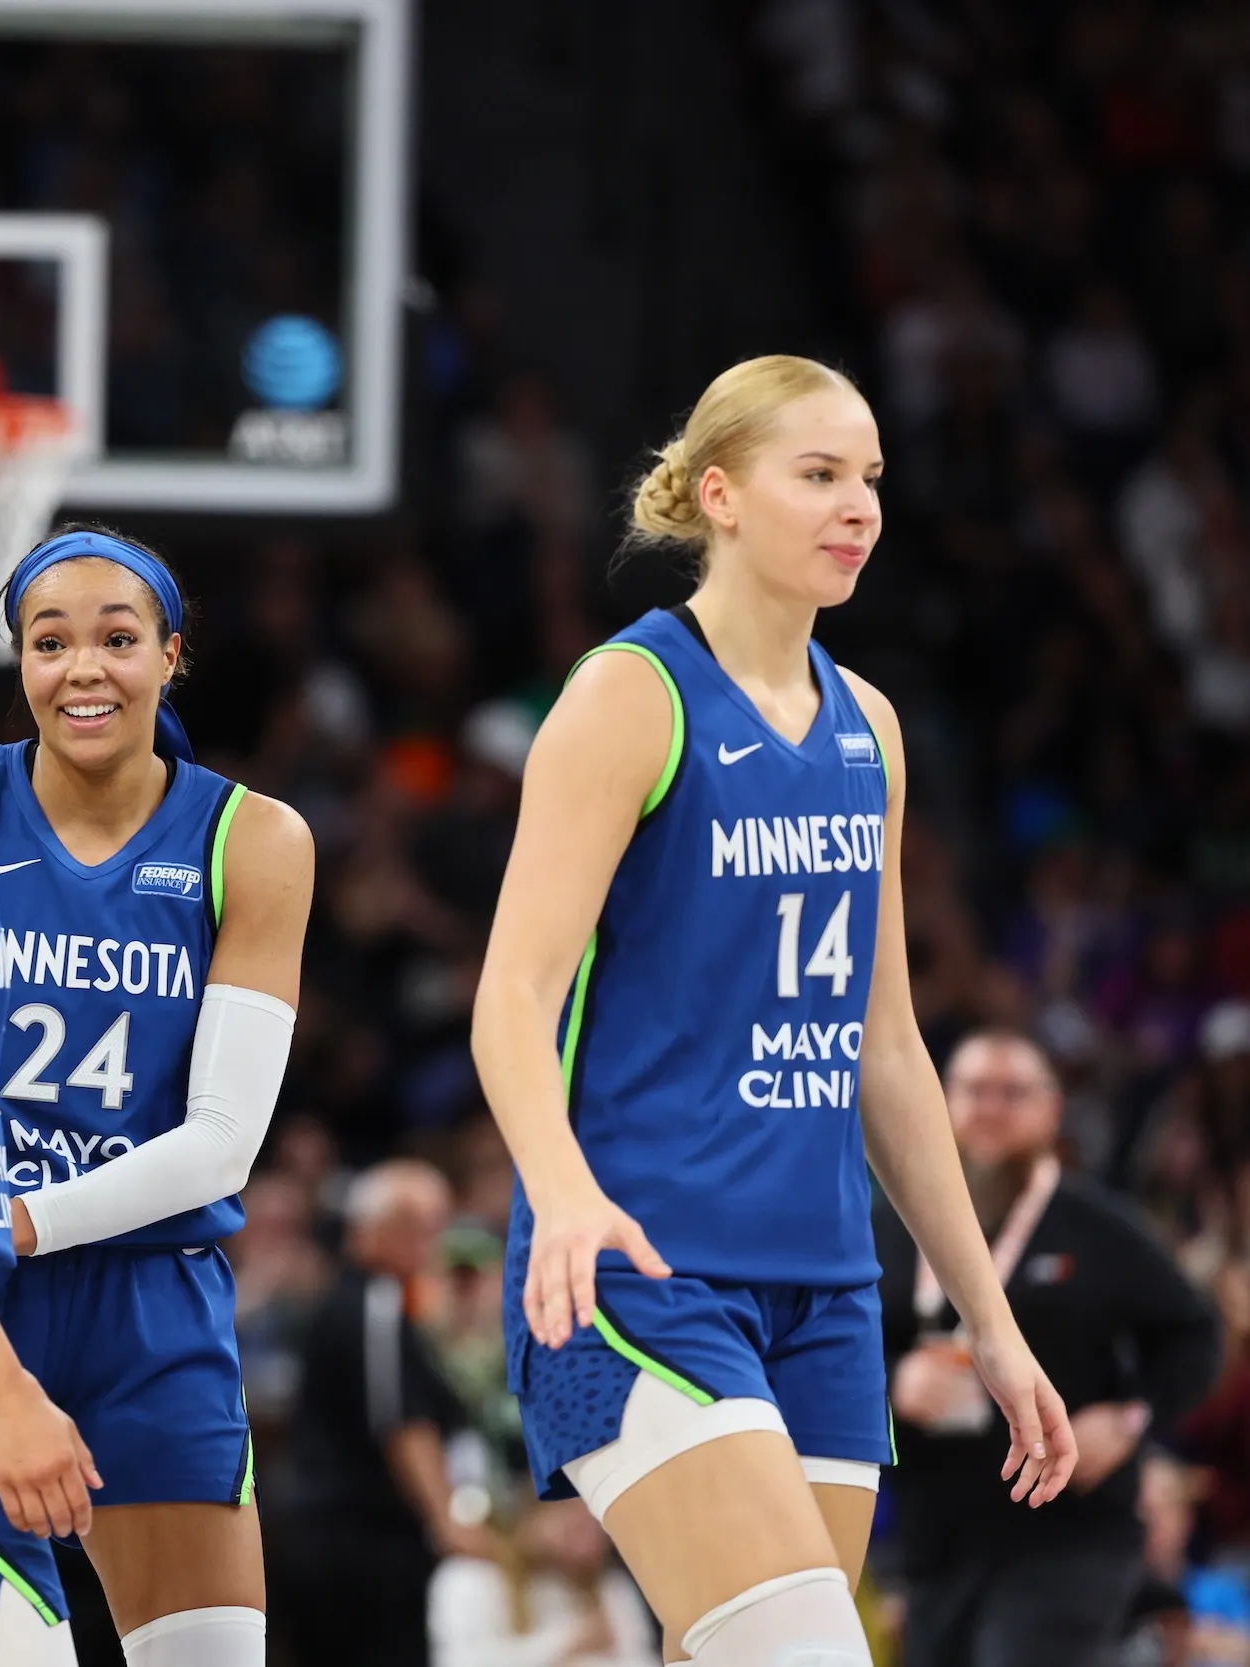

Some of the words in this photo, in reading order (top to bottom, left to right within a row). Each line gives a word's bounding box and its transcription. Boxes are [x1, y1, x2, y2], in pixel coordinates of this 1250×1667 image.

[136, 877, 182, 889] INSURANCE
[139, 866, 201, 884] FEDERATED
[776, 890, 853, 998] 14
[0, 1002, 133, 1110] 24
[752, 1021, 863, 1061] MAYO
[738, 1070, 855, 1109] CLINI
[9, 1118, 135, 1165] MAYO
